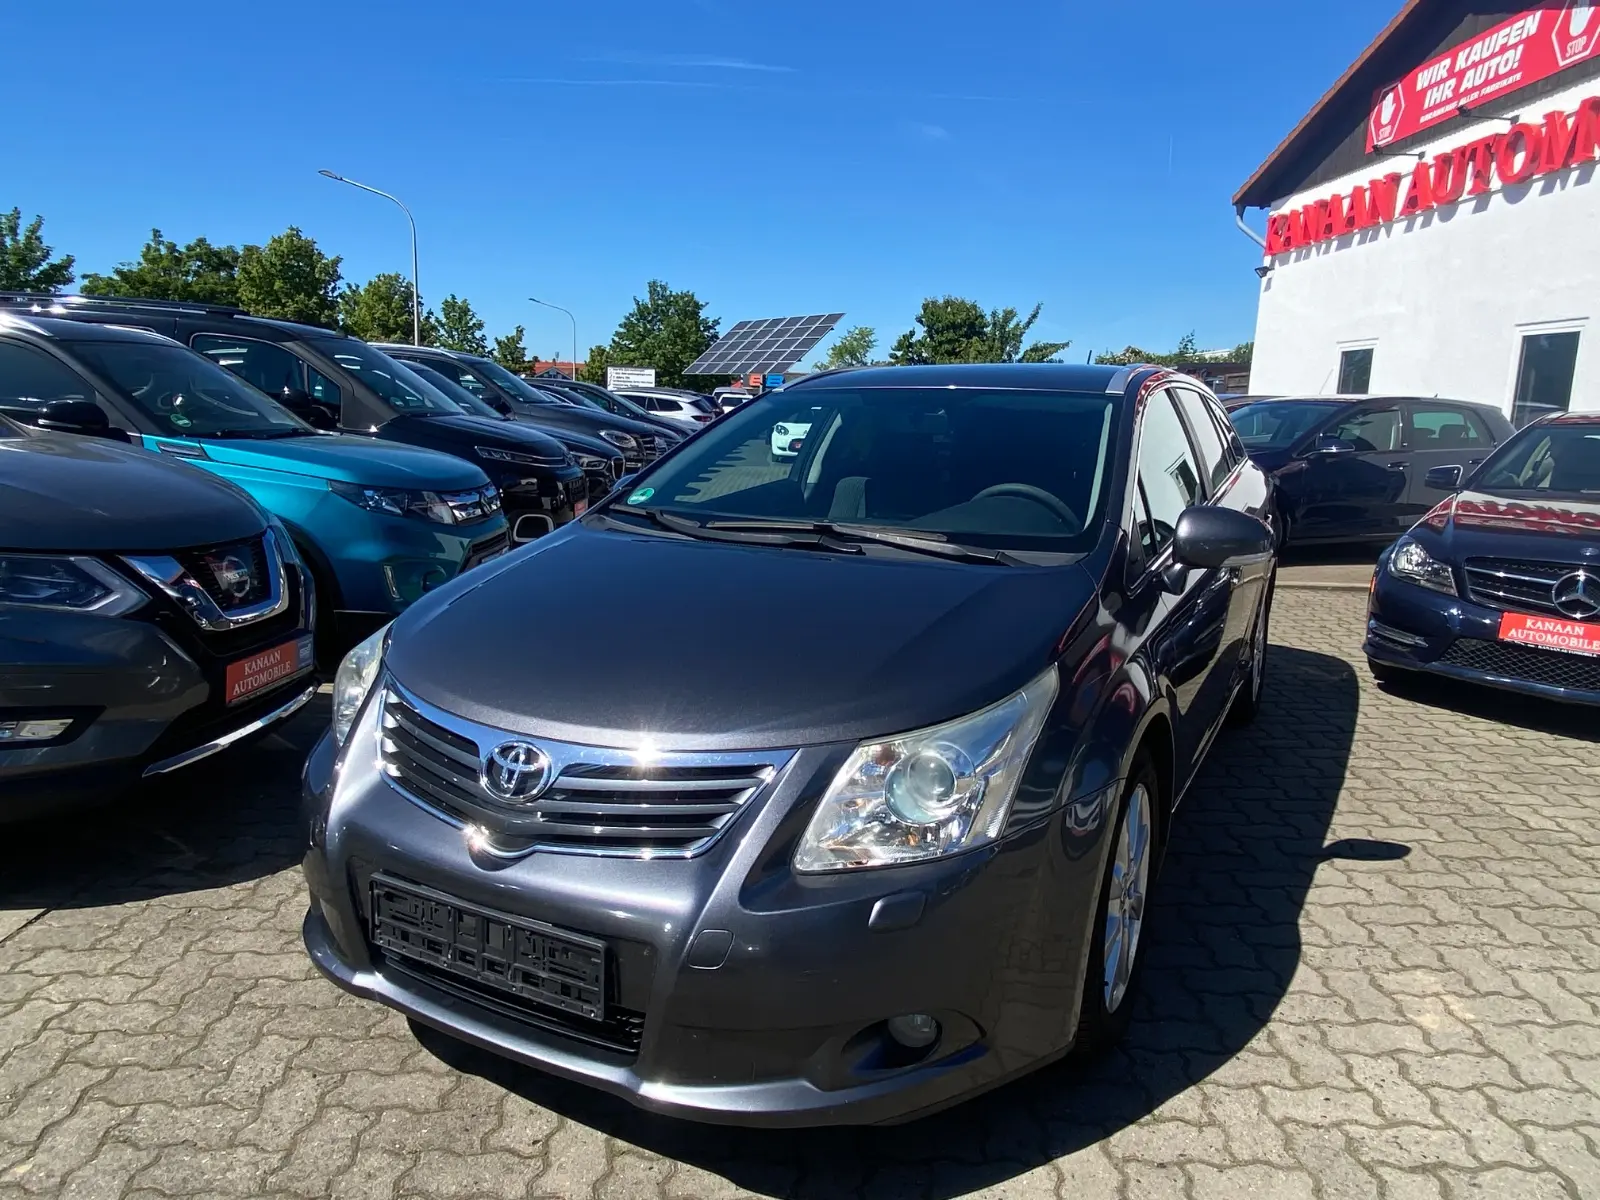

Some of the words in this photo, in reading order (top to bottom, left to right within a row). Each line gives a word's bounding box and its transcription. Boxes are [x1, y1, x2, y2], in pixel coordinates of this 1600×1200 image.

[1416, 57, 1451, 92] WIR
[1454, 10, 1543, 73] KAUFEN
[1566, 35, 1588, 58] STOP
[1423, 77, 1456, 110] IHR
[1459, 44, 1524, 93] AUTO!
[1480, 71, 1523, 97] FABRIKATE
[1264, 172, 1402, 257] KANAAN
[1508, 628, 1600, 651] AUTOMOBILE
[1525, 618, 1585, 636] KANAAN
[244, 650, 281, 675] KANAAN
[233, 661, 291, 696] AUTOMOBILE
